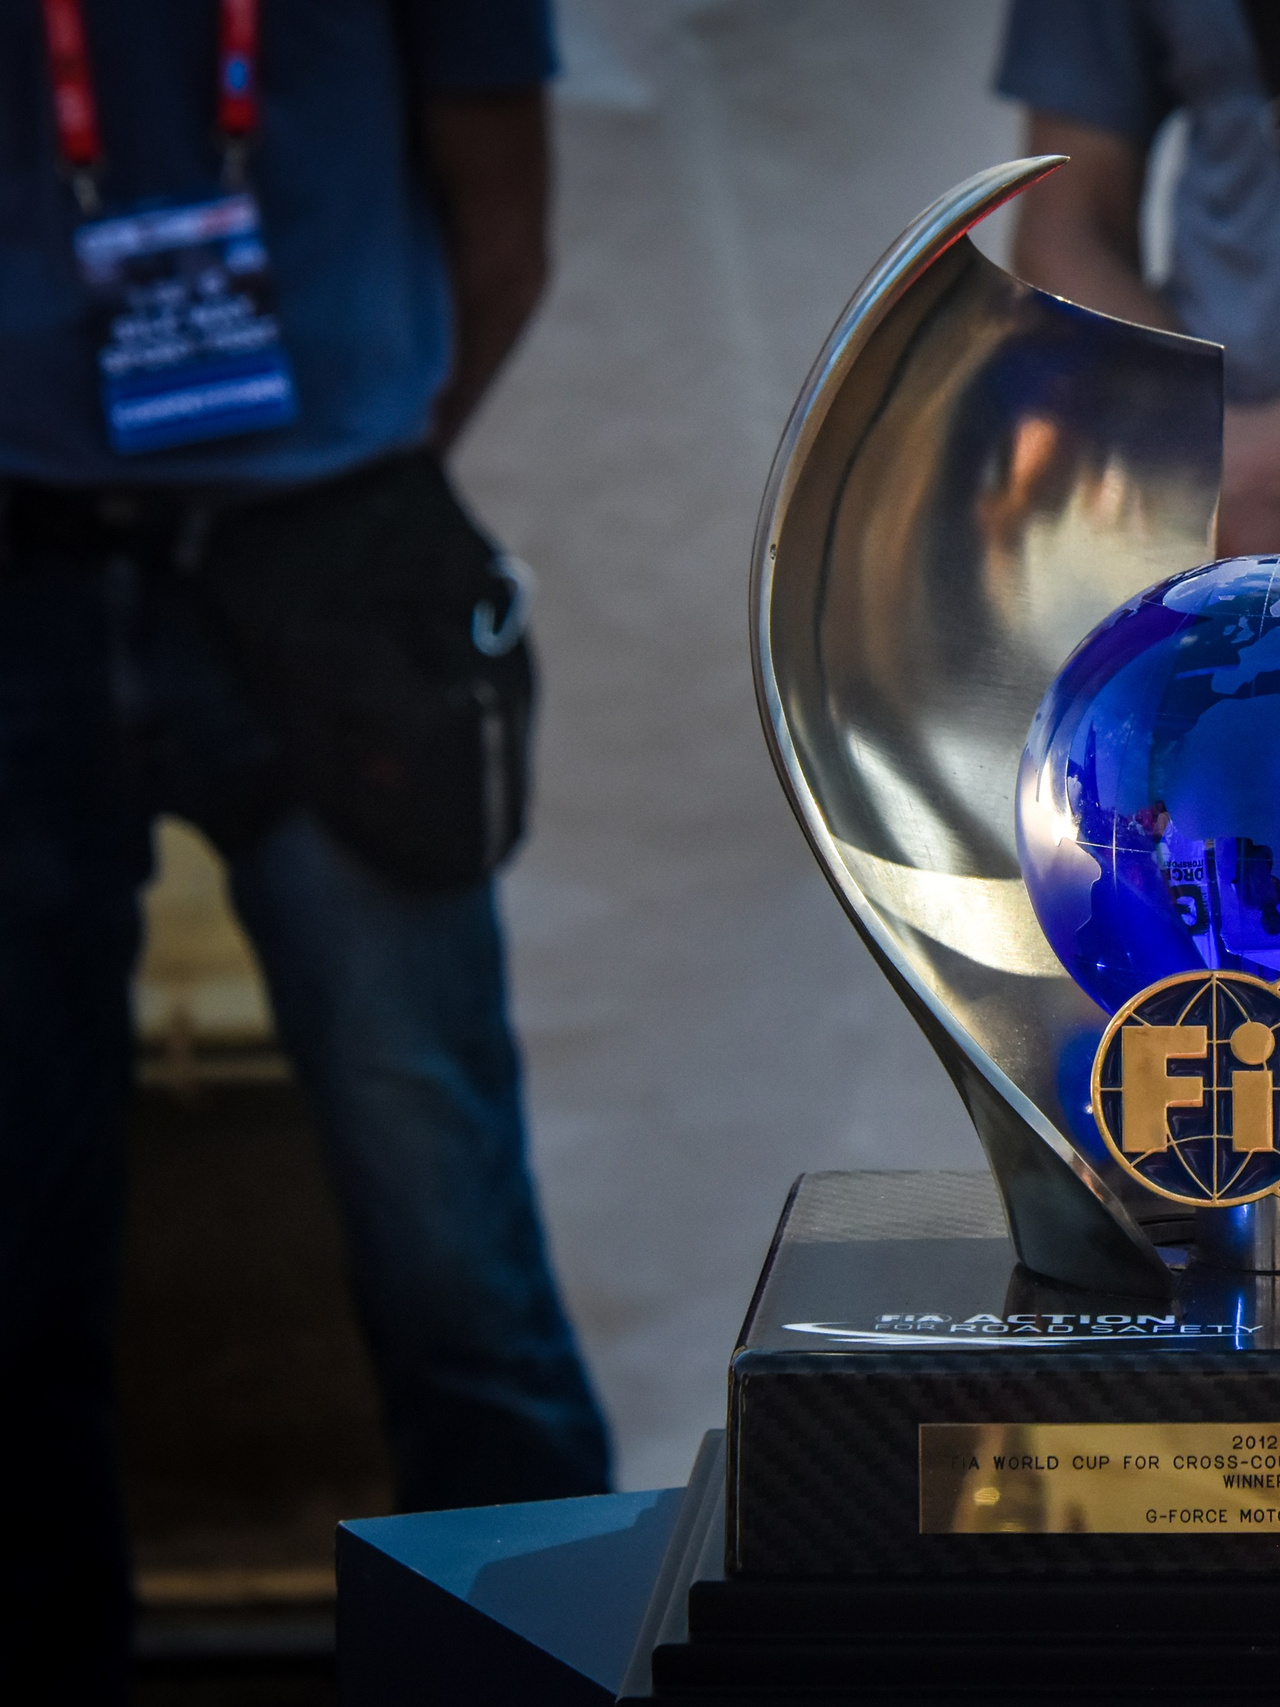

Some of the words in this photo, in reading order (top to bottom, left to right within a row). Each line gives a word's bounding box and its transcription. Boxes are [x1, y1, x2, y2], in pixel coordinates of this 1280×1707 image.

[880, 1314, 945, 1323] FIA
[963, 1314, 1176, 1324] ACTION
[949, 1324, 1075, 1333] ROAD
[1090, 1324, 1264, 1333] SAFETY
[1232, 1435, 1278, 1449] 2012
[993, 1456, 1060, 1470] WORLD
[1072, 1456, 1110, 1470] CUP
[1123, 1455, 1160, 1470] FOR
[1145, 1509, 1228, 1524] G-FORCE
